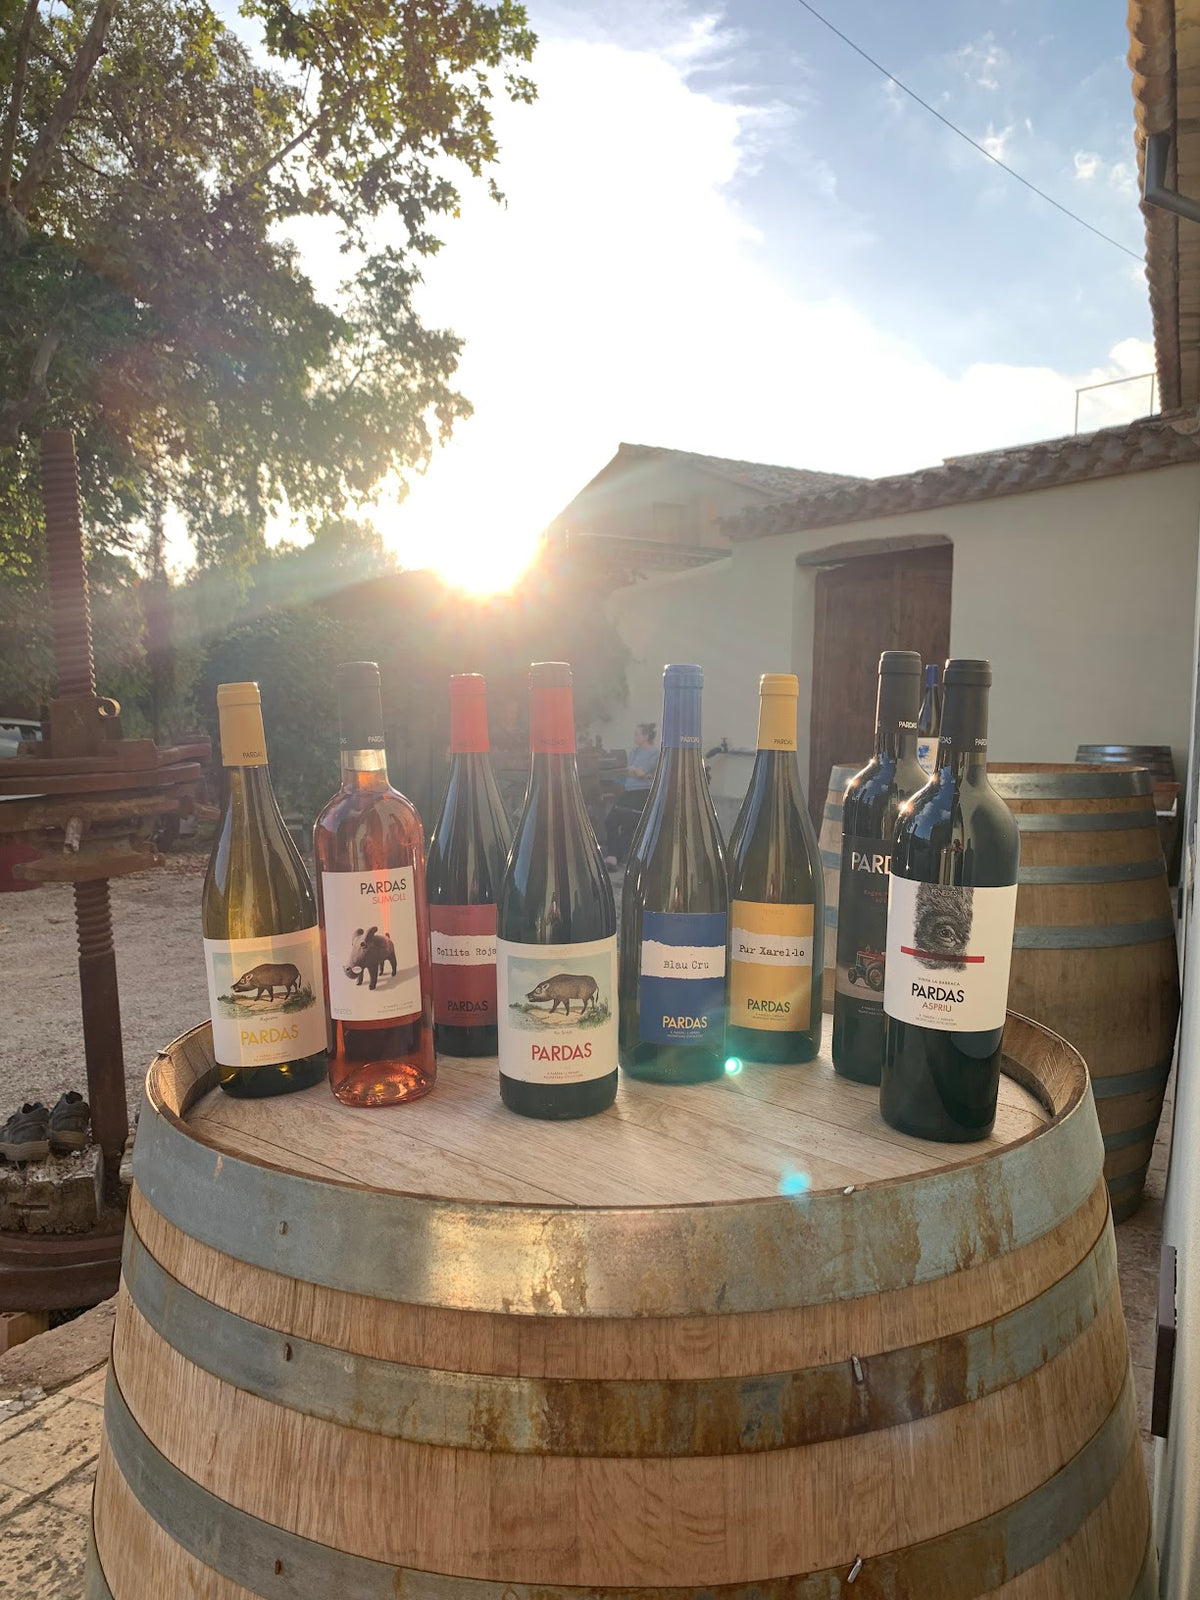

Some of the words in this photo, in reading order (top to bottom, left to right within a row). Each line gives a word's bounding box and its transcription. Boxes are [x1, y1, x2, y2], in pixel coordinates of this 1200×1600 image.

[851, 851, 892, 875] PARD
[360, 878, 407, 895] PARDAS
[372, 893, 406, 904] SUMOLL
[436, 947, 470, 957] Collita
[739, 943, 756, 955] Pur
[663, 960, 688, 970] Blau
[691, 960, 709, 970] Cru
[911, 982, 965, 1003] PARDAS
[447, 1000, 488, 1012] PARDAS
[747, 998, 791, 1013] PARDAS
[922, 1002, 952, 1013] ASPRIU
[662, 1015, 708, 1029] PARDAS
[240, 1023, 299, 1046] PARDAS
[531, 1042, 592, 1062] PARDAS
